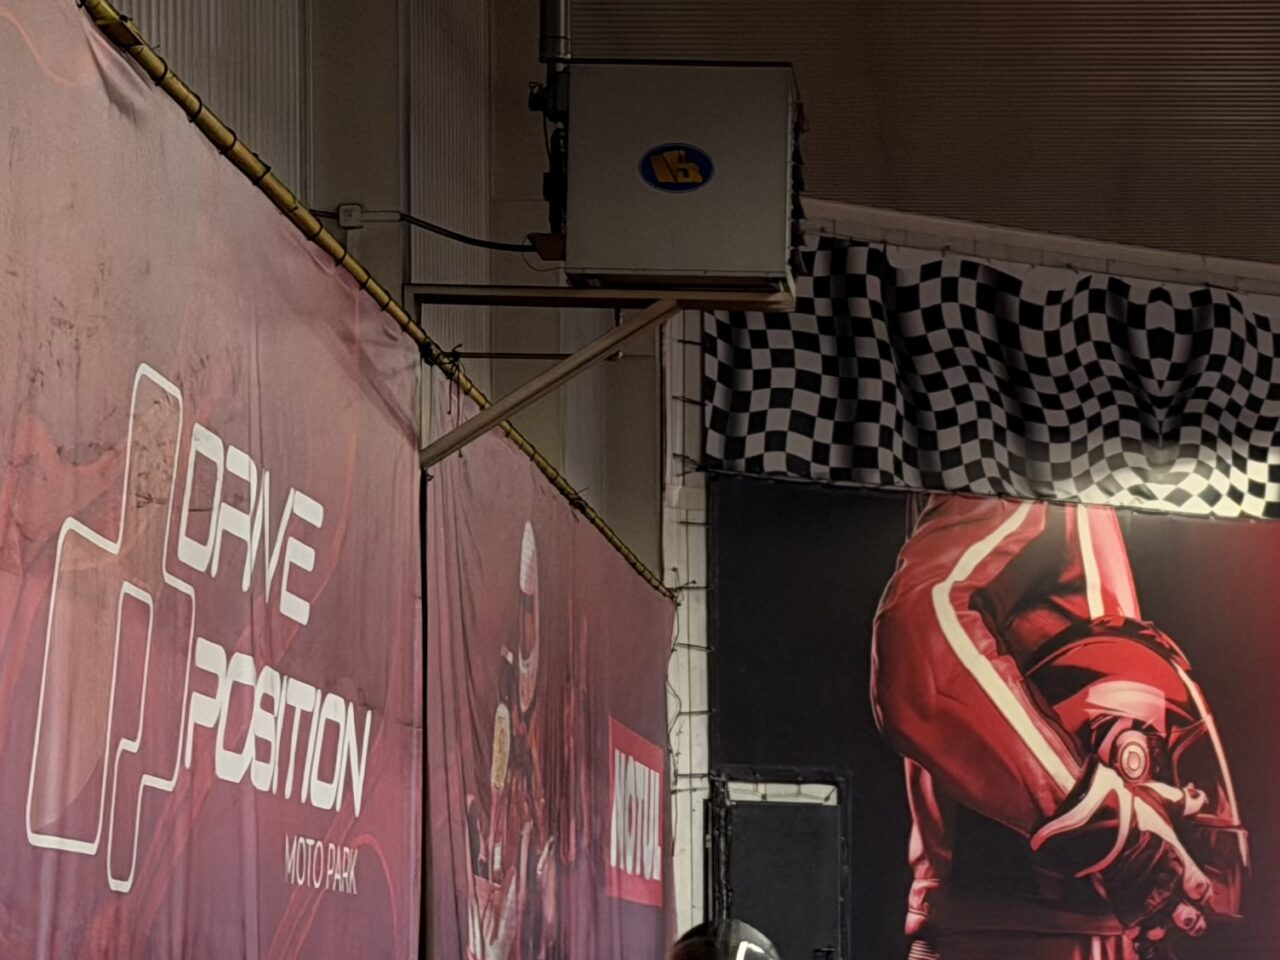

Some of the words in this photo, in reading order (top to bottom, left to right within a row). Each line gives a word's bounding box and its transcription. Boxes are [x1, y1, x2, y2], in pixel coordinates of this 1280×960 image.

[177, 422, 324, 625] DRIVE
[184, 637, 372, 818] POSITION
[284, 834, 325, 889] MOTO
[325, 843, 359, 895] PARK
